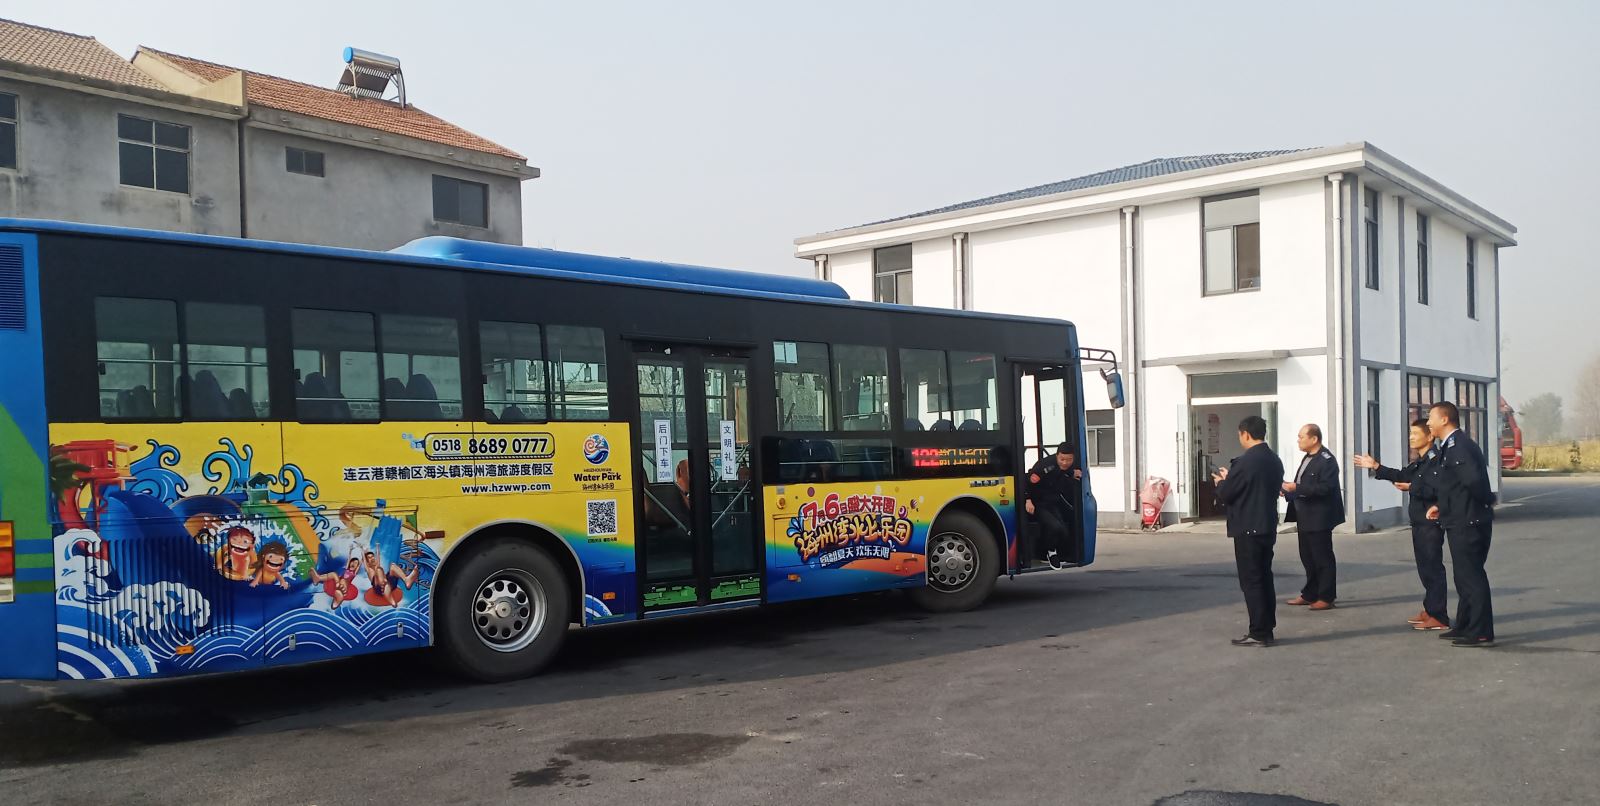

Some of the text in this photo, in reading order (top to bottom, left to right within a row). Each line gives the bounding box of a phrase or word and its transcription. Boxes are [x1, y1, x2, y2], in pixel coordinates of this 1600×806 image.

[433, 438, 548, 454] 0518 8689 0777
[658, 424, 670, 468] 后门下车
[723, 425, 734, 475] 文明礼让
[343, 463, 554, 481] 连云港赣榆区海头镇海州湾旅游度假区
[573, 473, 601, 482] Water
[601, 472, 622, 481] Park
[461, 482, 551, 493] www.hzwwp.com
[794, 513, 913, 563] 海州湾水上乐园
[855, 545, 891, 560] 欢乐无限
